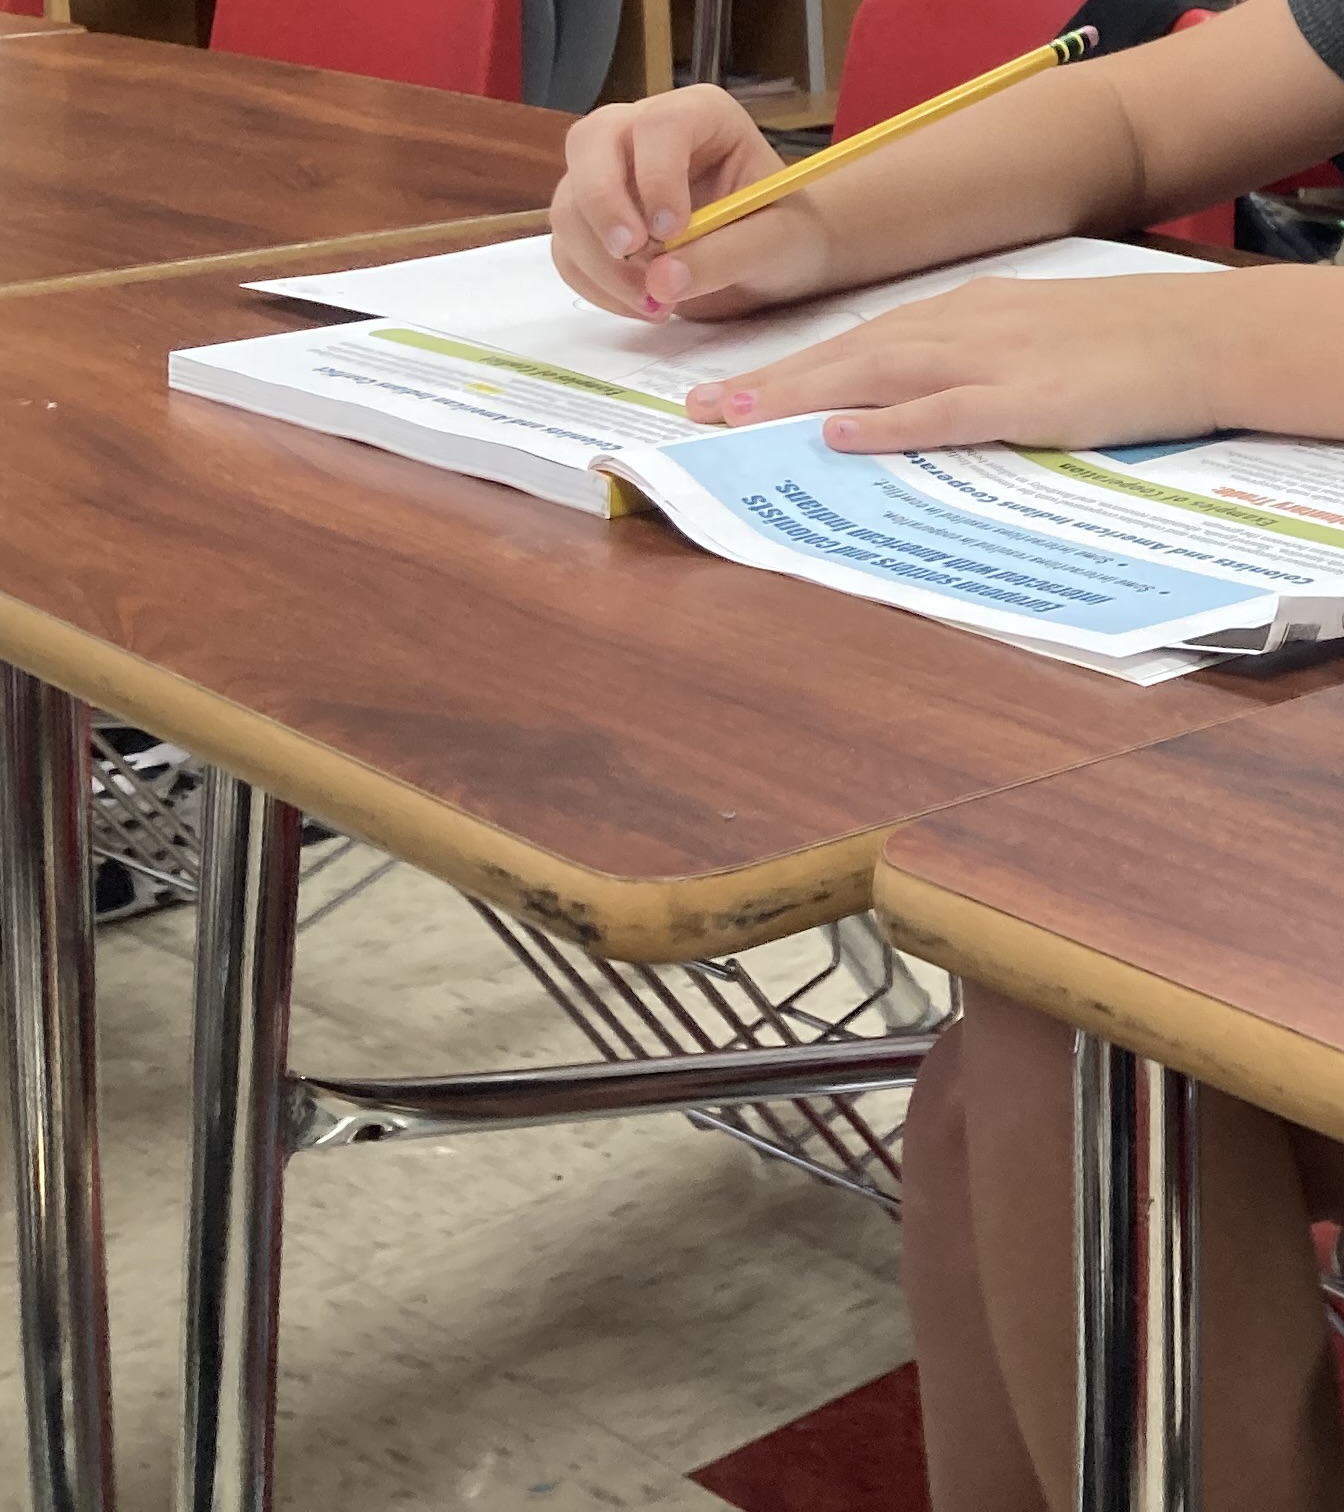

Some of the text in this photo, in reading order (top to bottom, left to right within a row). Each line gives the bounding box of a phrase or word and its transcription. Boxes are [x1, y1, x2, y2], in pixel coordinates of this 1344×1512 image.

[869, 478, 929, 510] conflict.
[1058, 462, 1166, 501] Cooperation
[773, 479, 860, 537] Indians.
[942, 509, 998, 534] resulted
[997, 499, 1076, 527] Indians
[1191, 500, 1279, 528] Examples
[847, 524, 952, 565] American
[977, 537, 1031, 563] resulted
[997, 526, 1083, 559] interactions
[1070, 521, 1173, 551] American
[740, 493, 1067, 614] European settlers and colonists
[942, 553, 1000, 578] with
[1079, 547, 1116, 566] Some
[1164, 546, 1215, 563] and
[1030, 555, 1117, 584] interactions
[1211, 557, 1316, 586] Colonists
[1114, 577, 1156, 593] Some
